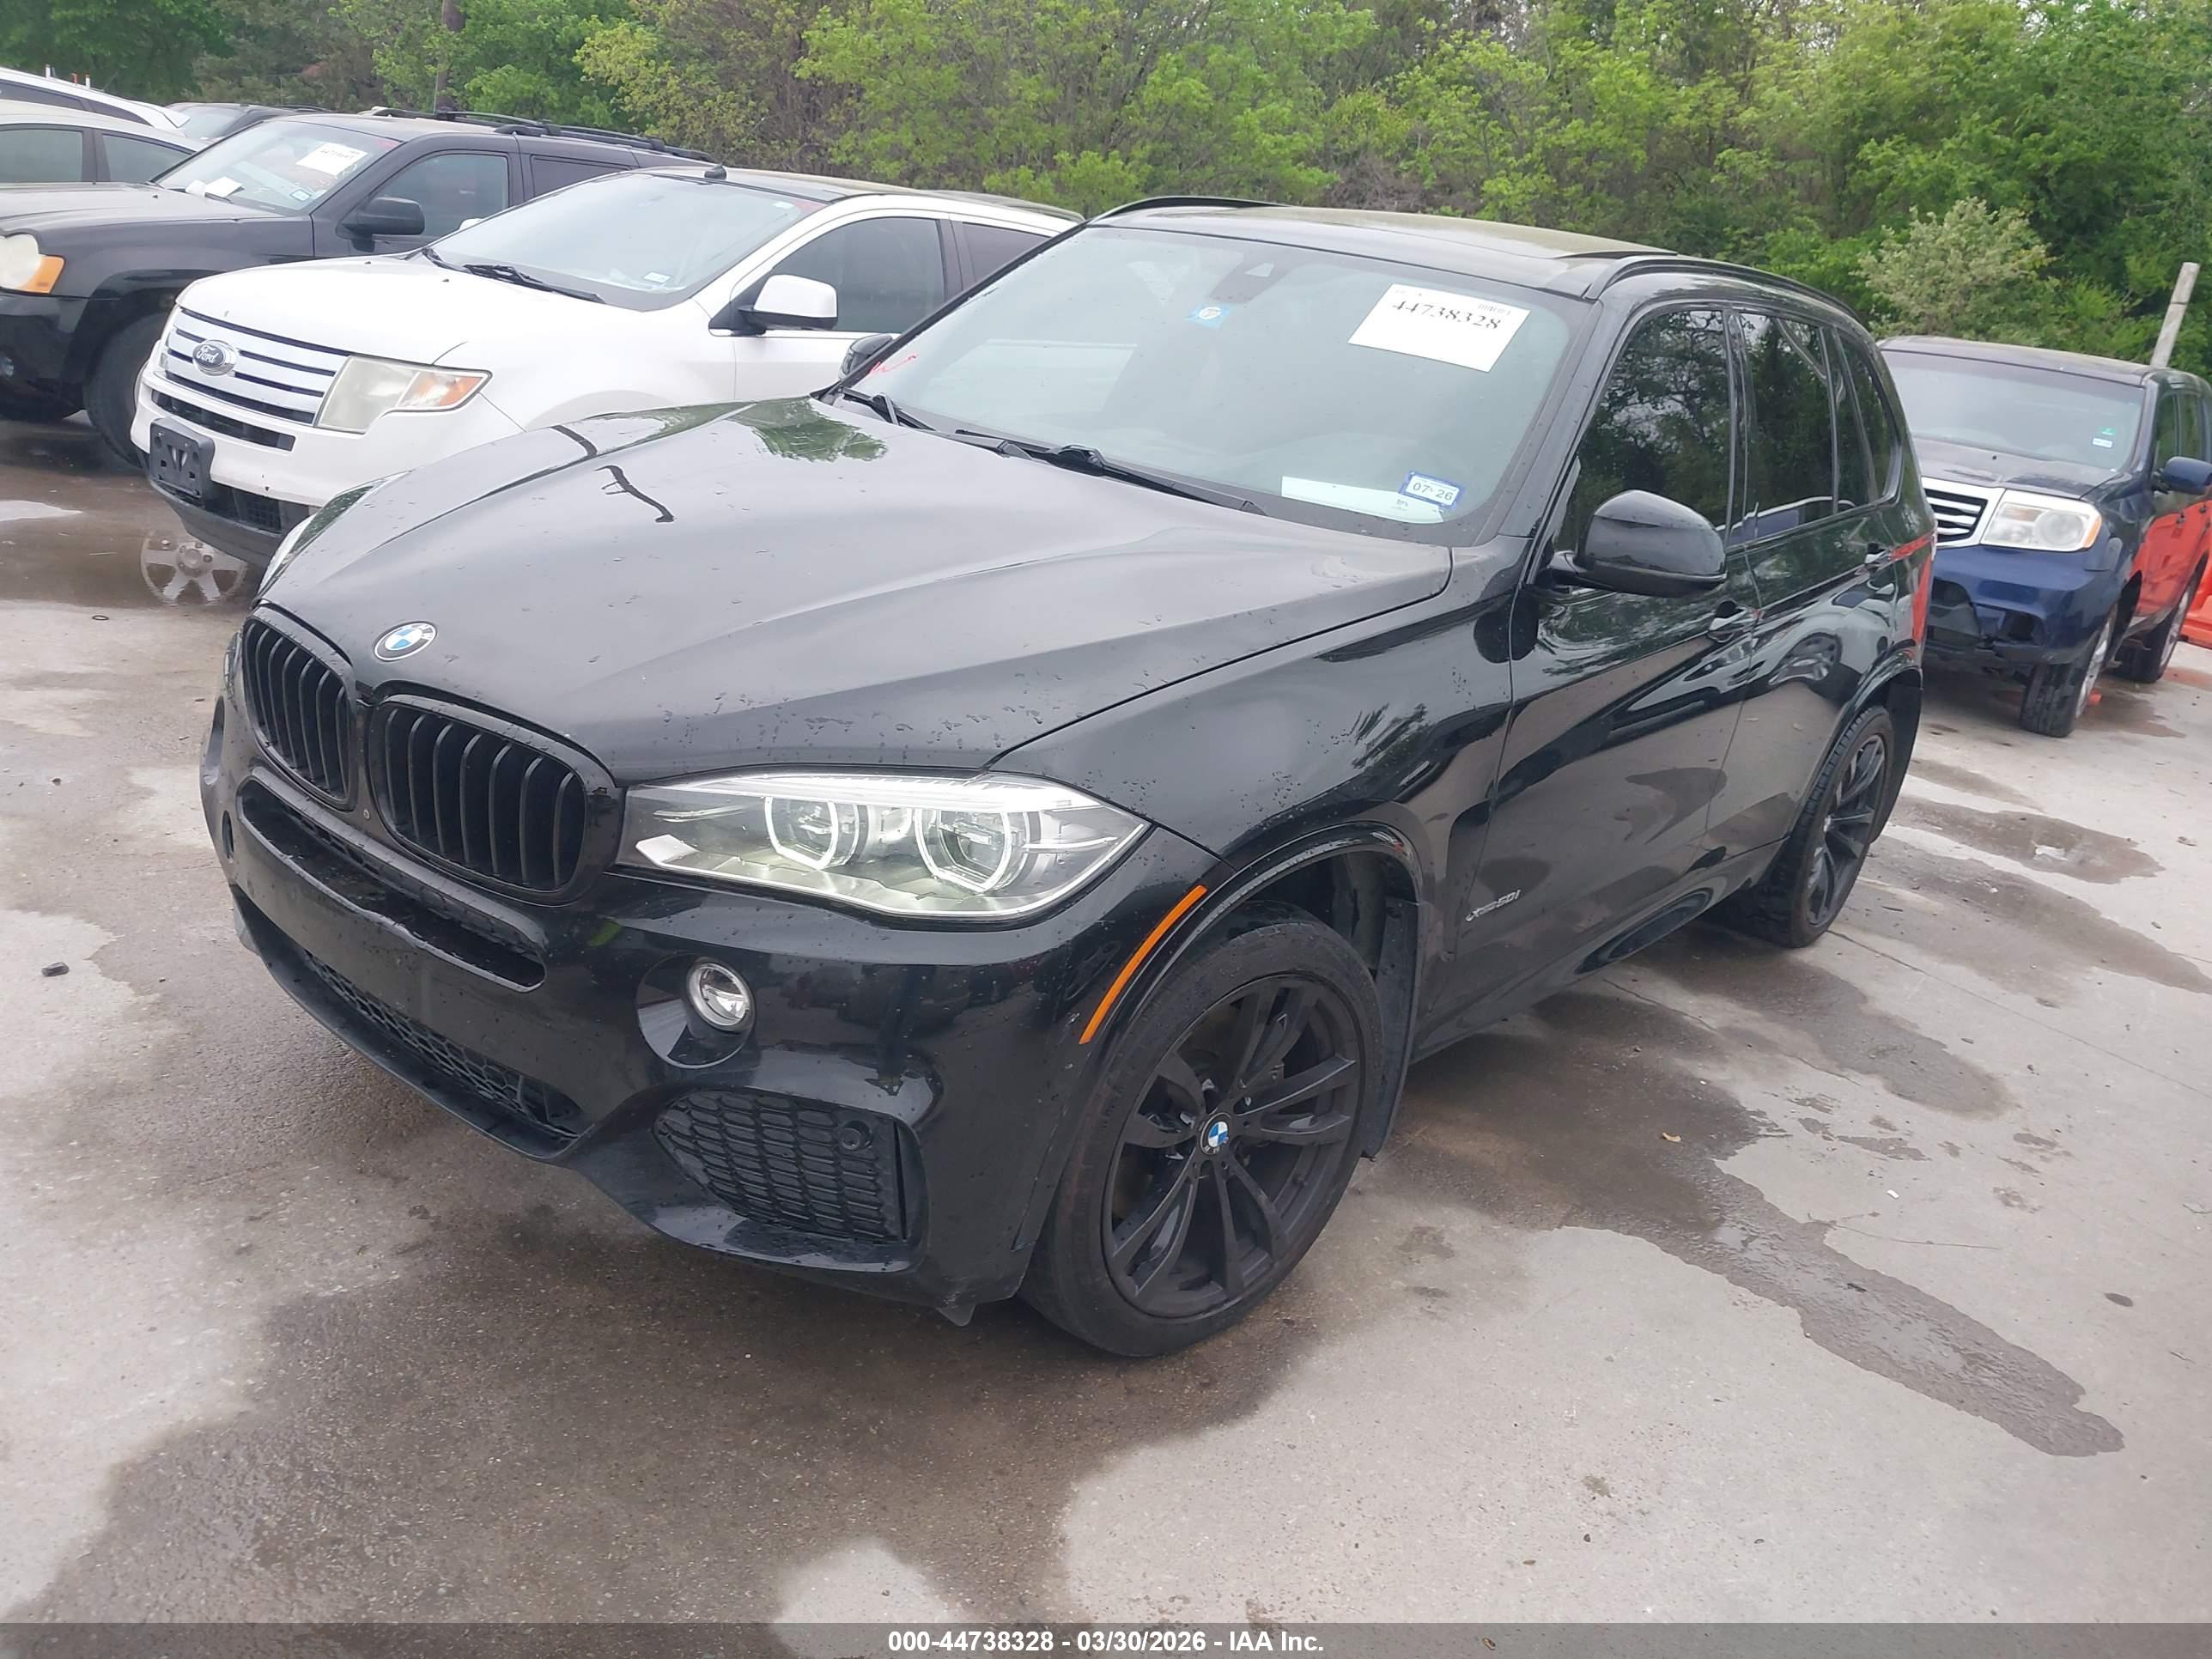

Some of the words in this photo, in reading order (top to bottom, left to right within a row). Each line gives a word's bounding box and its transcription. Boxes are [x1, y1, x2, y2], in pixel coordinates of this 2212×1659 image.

[1392, 301, 1501, 329] 44738328
[197, 344, 220, 363] Ford
[1413, 482, 1431, 494] 07
[1435, 489, 1454, 501] 26
